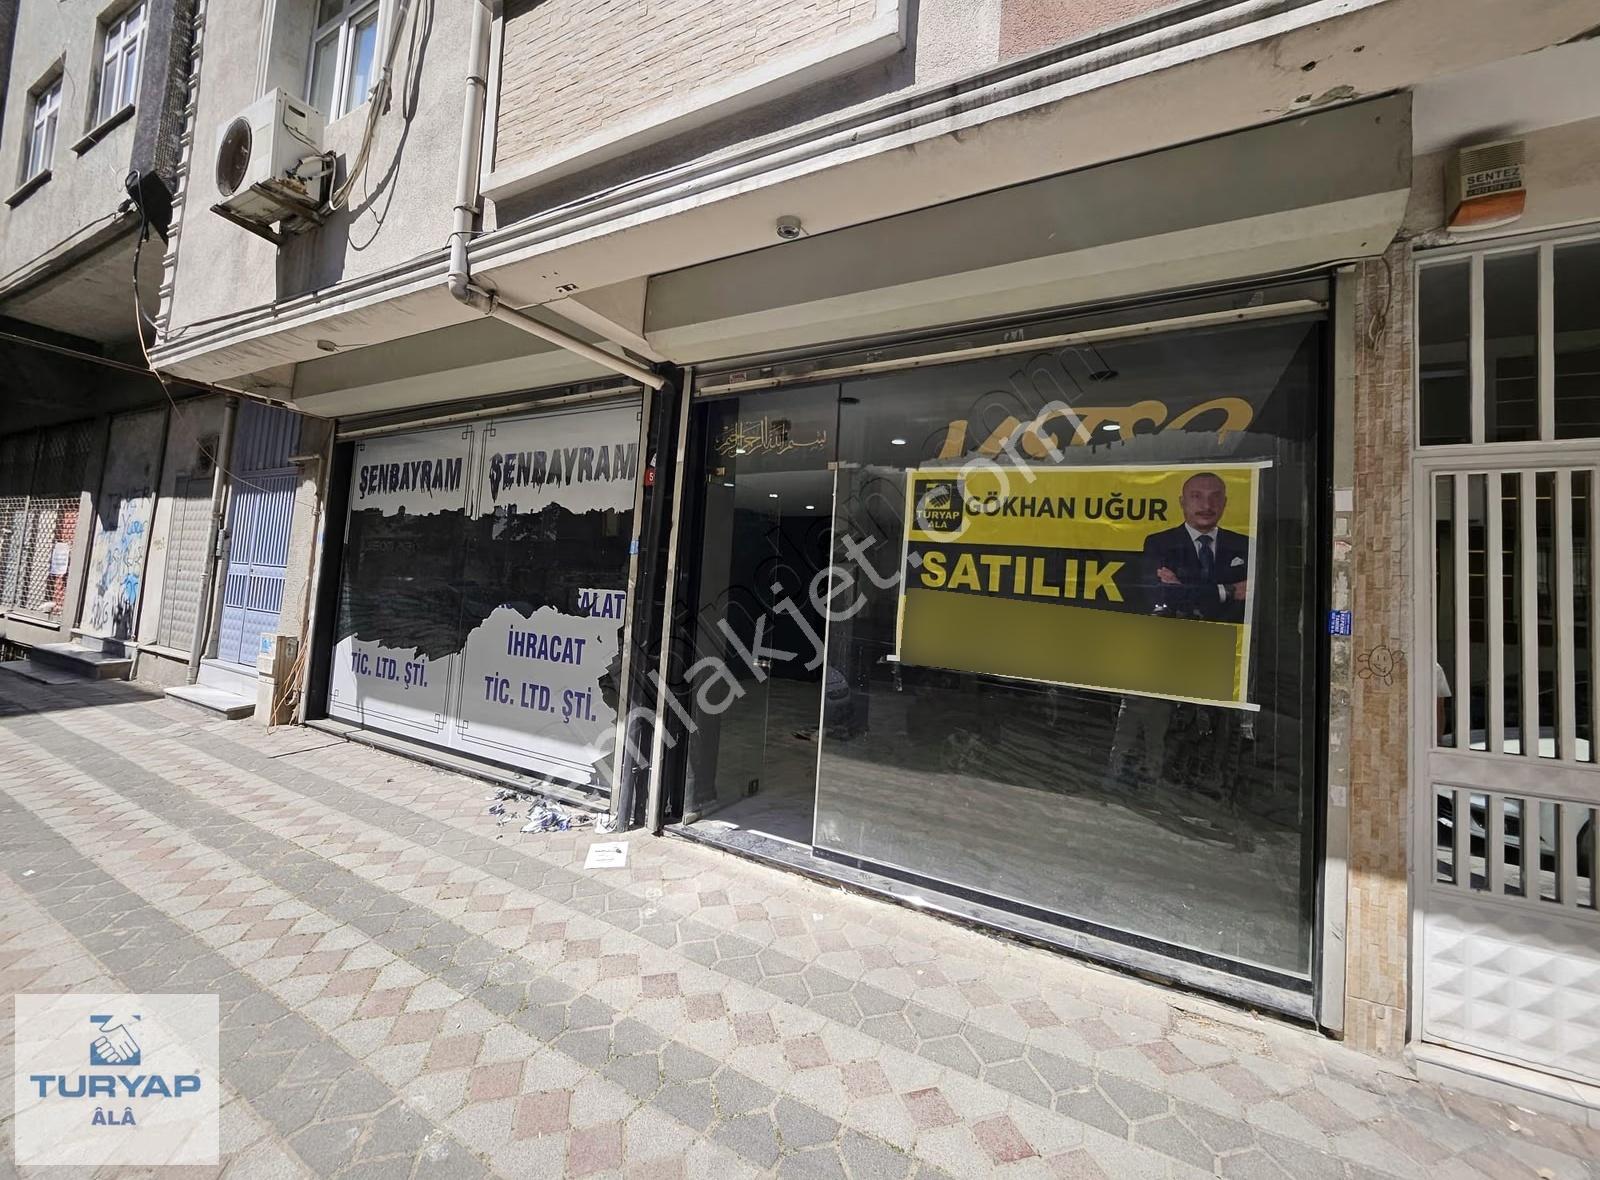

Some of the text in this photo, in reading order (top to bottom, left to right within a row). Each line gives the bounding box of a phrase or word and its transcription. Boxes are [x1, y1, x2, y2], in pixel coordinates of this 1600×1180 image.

[1467, 167, 1520, 185] SENTEZ
[360, 457, 462, 499] ŞENBAYRAM
[489, 443, 638, 502] ŞENBAYRAM
[916, 510, 960, 520] TURYAP
[965, 491, 1168, 522] GÖKHAN UĞUR
[920, 551, 1126, 602] SATILIK
[507, 624, 586, 665] İHRACAT
[351, 648, 428, 690] TİC. LTD. ŞTİ.
[485, 672, 596, 724] TİC. LTD. ŞTİ.
